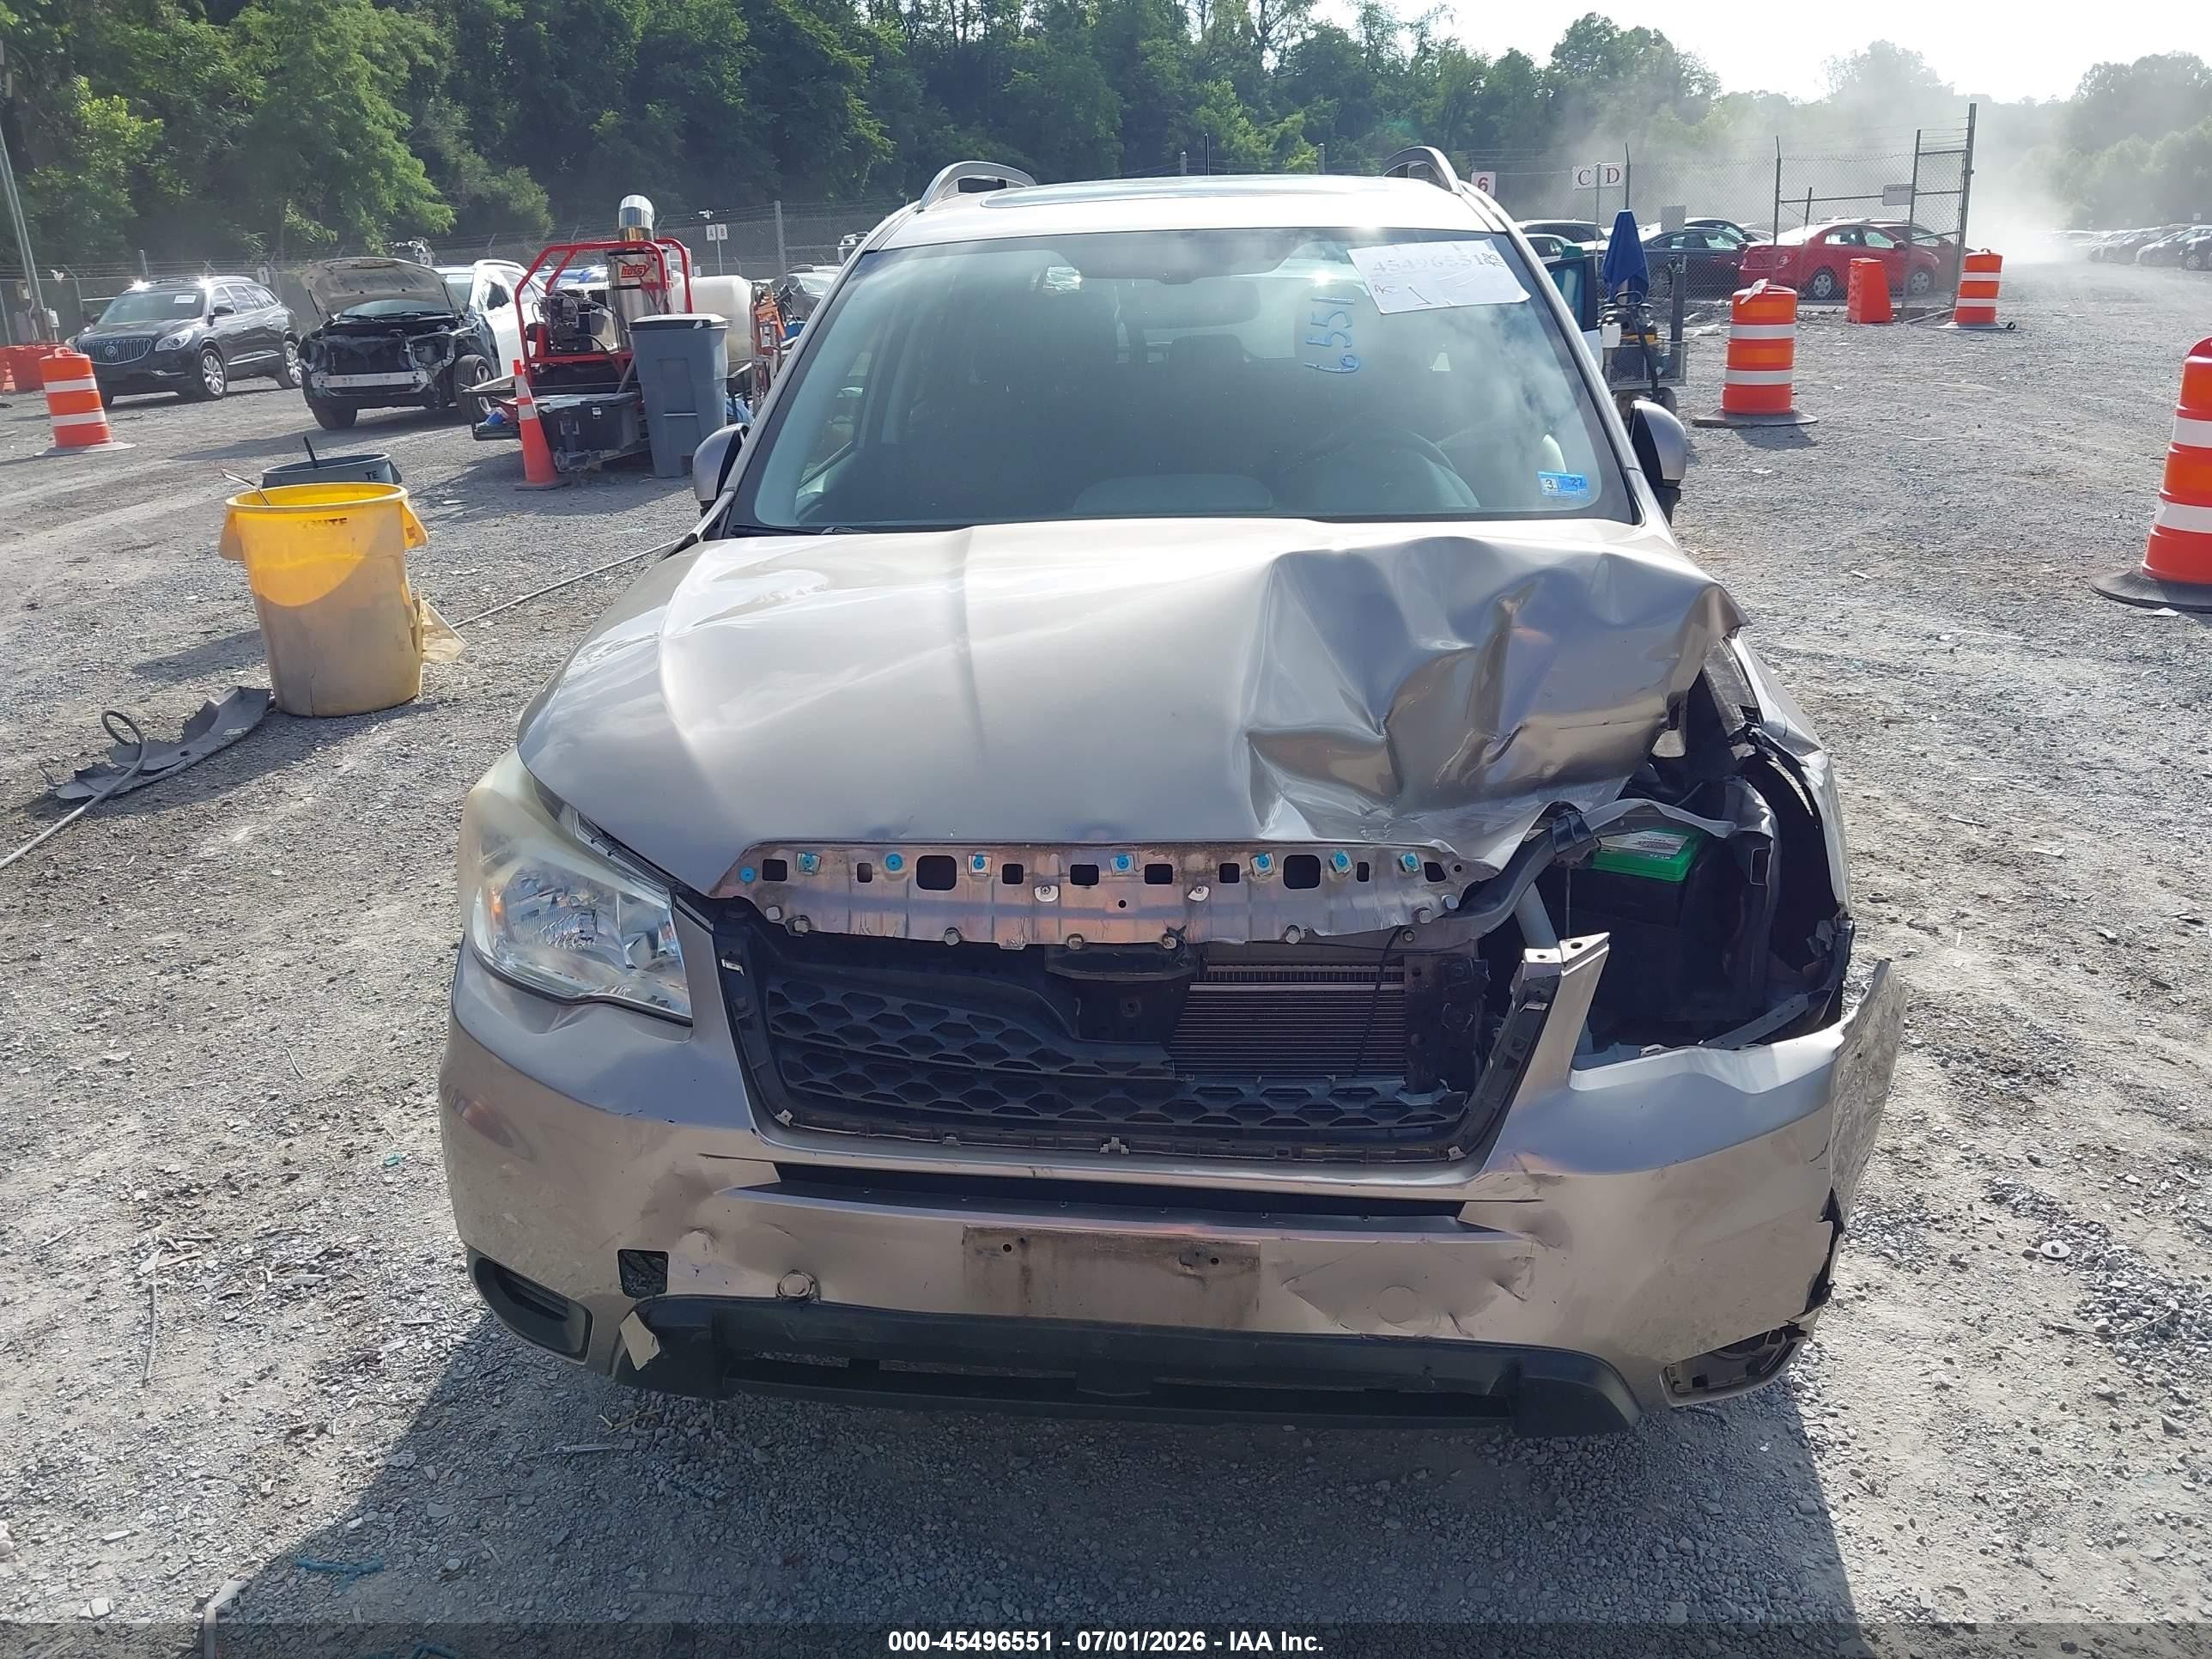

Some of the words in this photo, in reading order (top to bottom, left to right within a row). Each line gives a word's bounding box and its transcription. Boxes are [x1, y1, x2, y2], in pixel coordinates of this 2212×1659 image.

[1577, 169, 1591, 185] C
[1607, 167, 1620, 185] D
[1477, 177, 1489, 192] 6
[1304, 295, 1361, 374] 6551
[1545, 478, 1554, 489] 3
